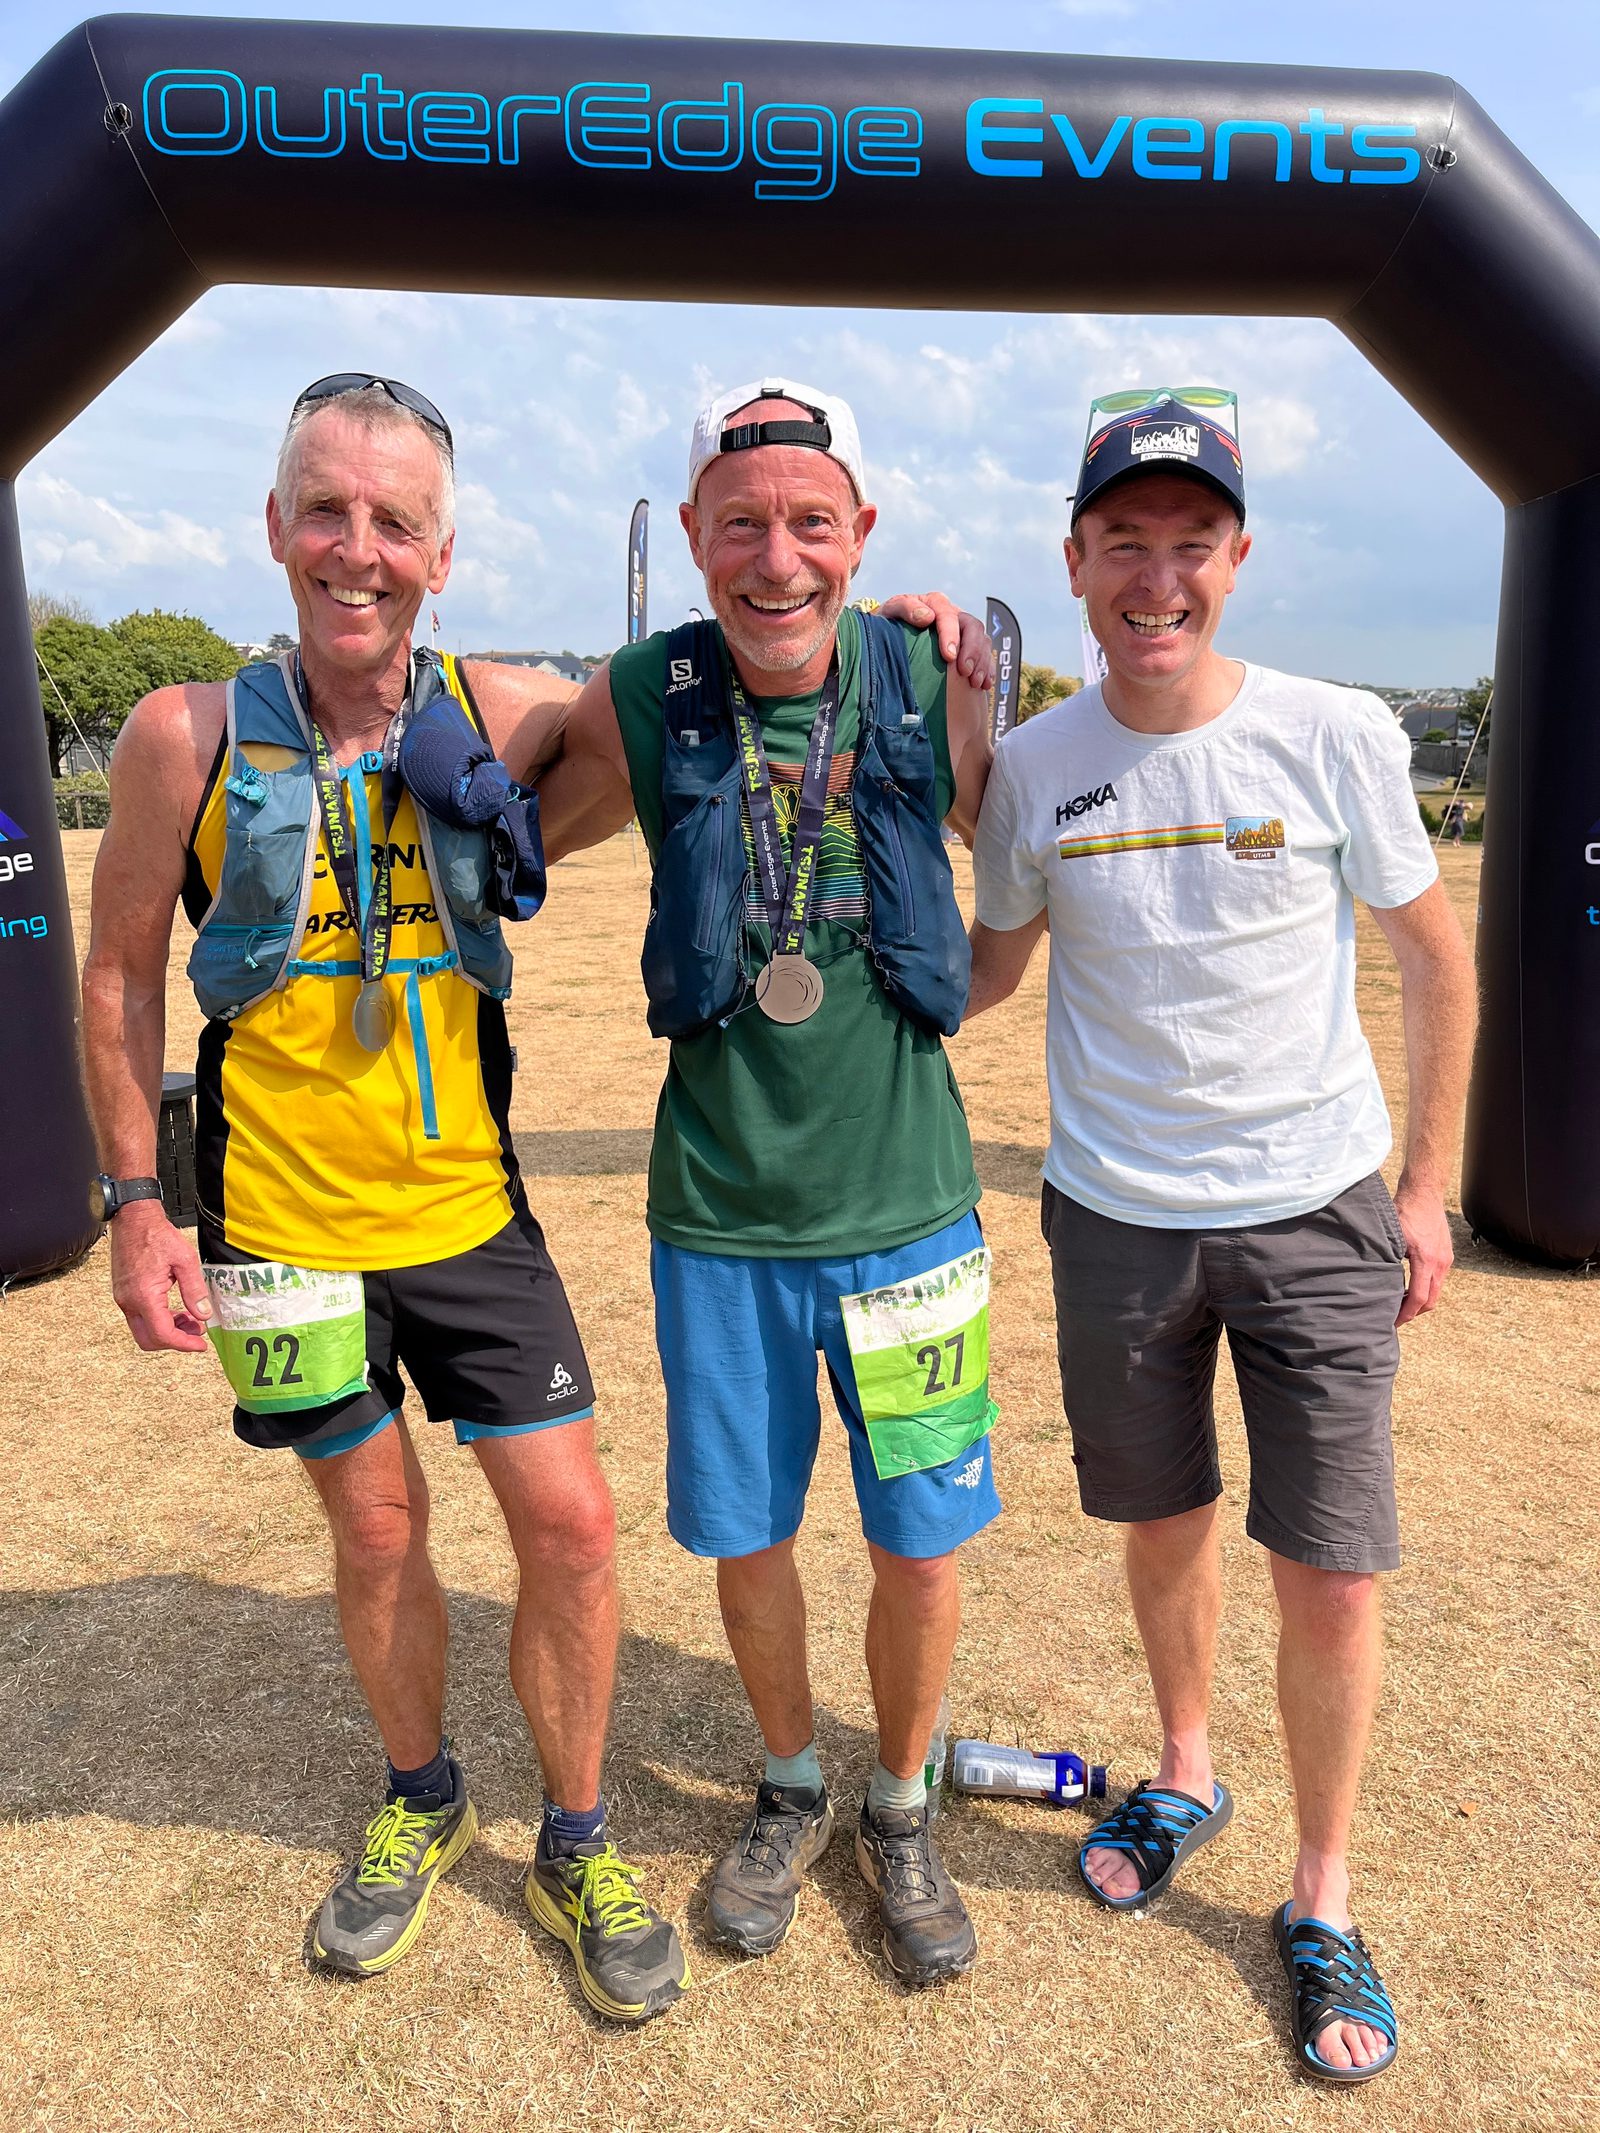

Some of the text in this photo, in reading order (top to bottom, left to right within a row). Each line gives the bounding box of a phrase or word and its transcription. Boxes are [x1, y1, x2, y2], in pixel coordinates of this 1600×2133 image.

[143, 69, 1421, 200] OuterEdge Events
[391, 741, 402, 772] Events
[814, 701, 834, 780] OuterEdge Events
[321, 781, 347, 859] TSUNAMI
[1055, 782, 1119, 827] HOKA
[761, 820, 780, 901] OuterEdge Events
[245, 1333, 303, 1387] 22
[917, 1331, 965, 1396] 27
[546, 1385, 579, 1402] odlo
